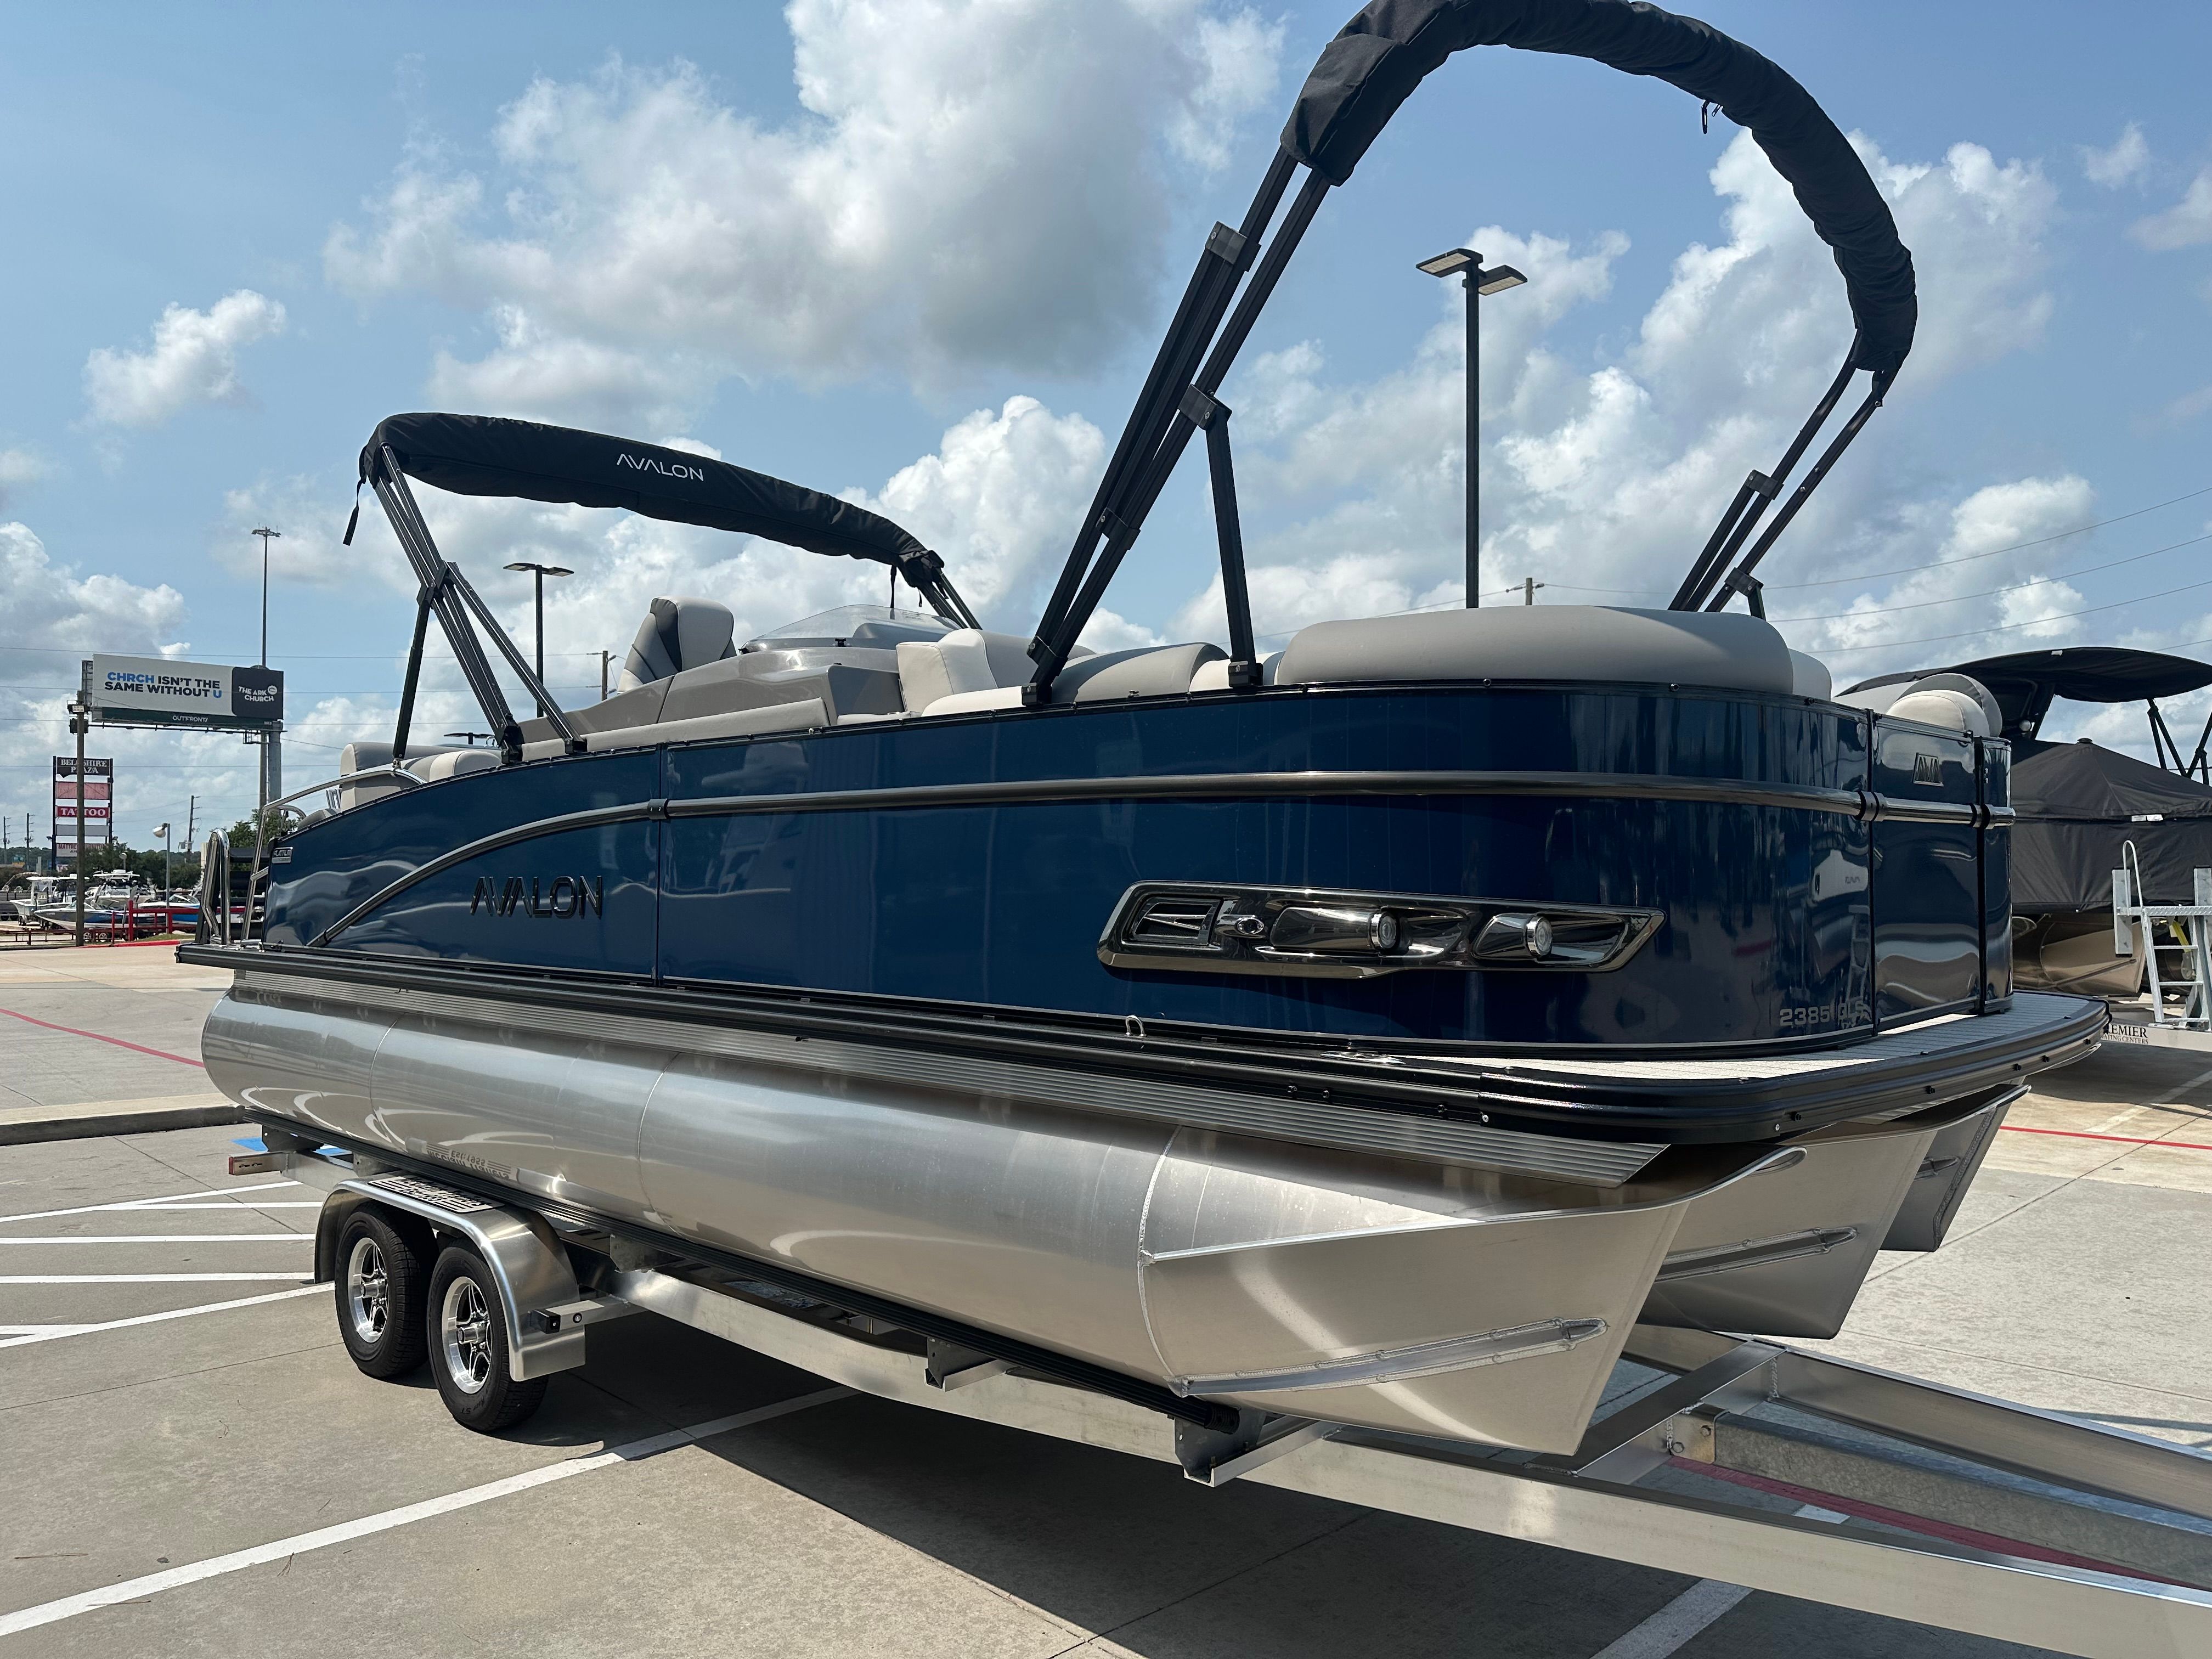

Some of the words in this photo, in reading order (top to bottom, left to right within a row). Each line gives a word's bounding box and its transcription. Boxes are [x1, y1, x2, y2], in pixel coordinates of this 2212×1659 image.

[617, 453, 704, 482] AVALON
[107, 672, 155, 684] CHRCH
[158, 675, 191, 686] ISN'T
[194, 679, 220, 689] THE
[104, 681, 144, 692] SAME
[146, 684, 210, 697] WITHOUT
[213, 690, 222, 698] U
[238, 686, 252, 695] THE
[244, 694, 274, 702] CHURCH
[470, 876, 603, 919] AVALON
[1780, 1005, 1830, 1027] 2385
